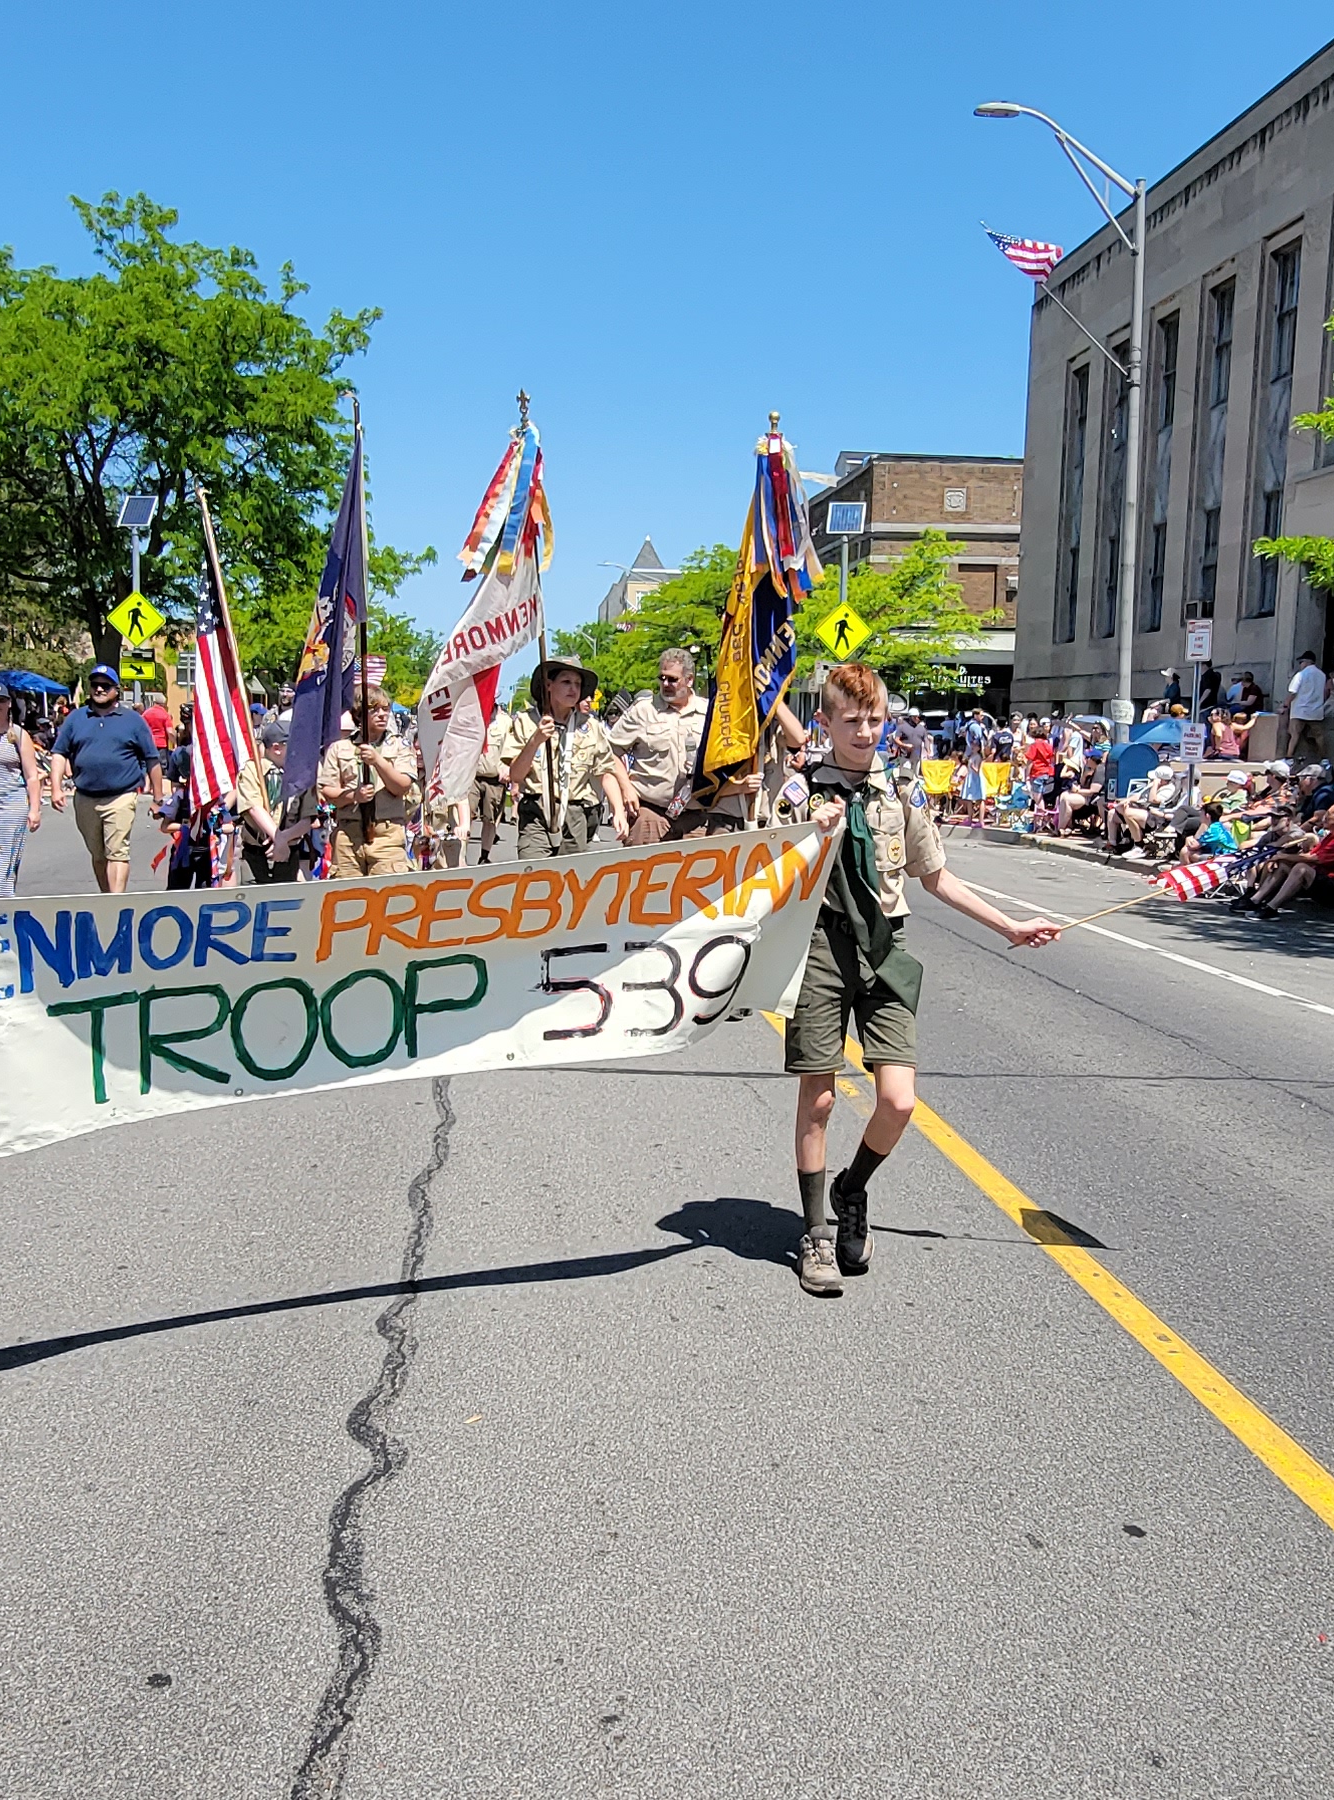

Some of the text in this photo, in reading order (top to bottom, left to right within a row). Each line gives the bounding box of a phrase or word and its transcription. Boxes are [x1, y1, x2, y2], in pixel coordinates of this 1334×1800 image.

[314, 835, 833, 963] PRESBYTERIAN
[45, 934, 753, 1105] TROOP 539
